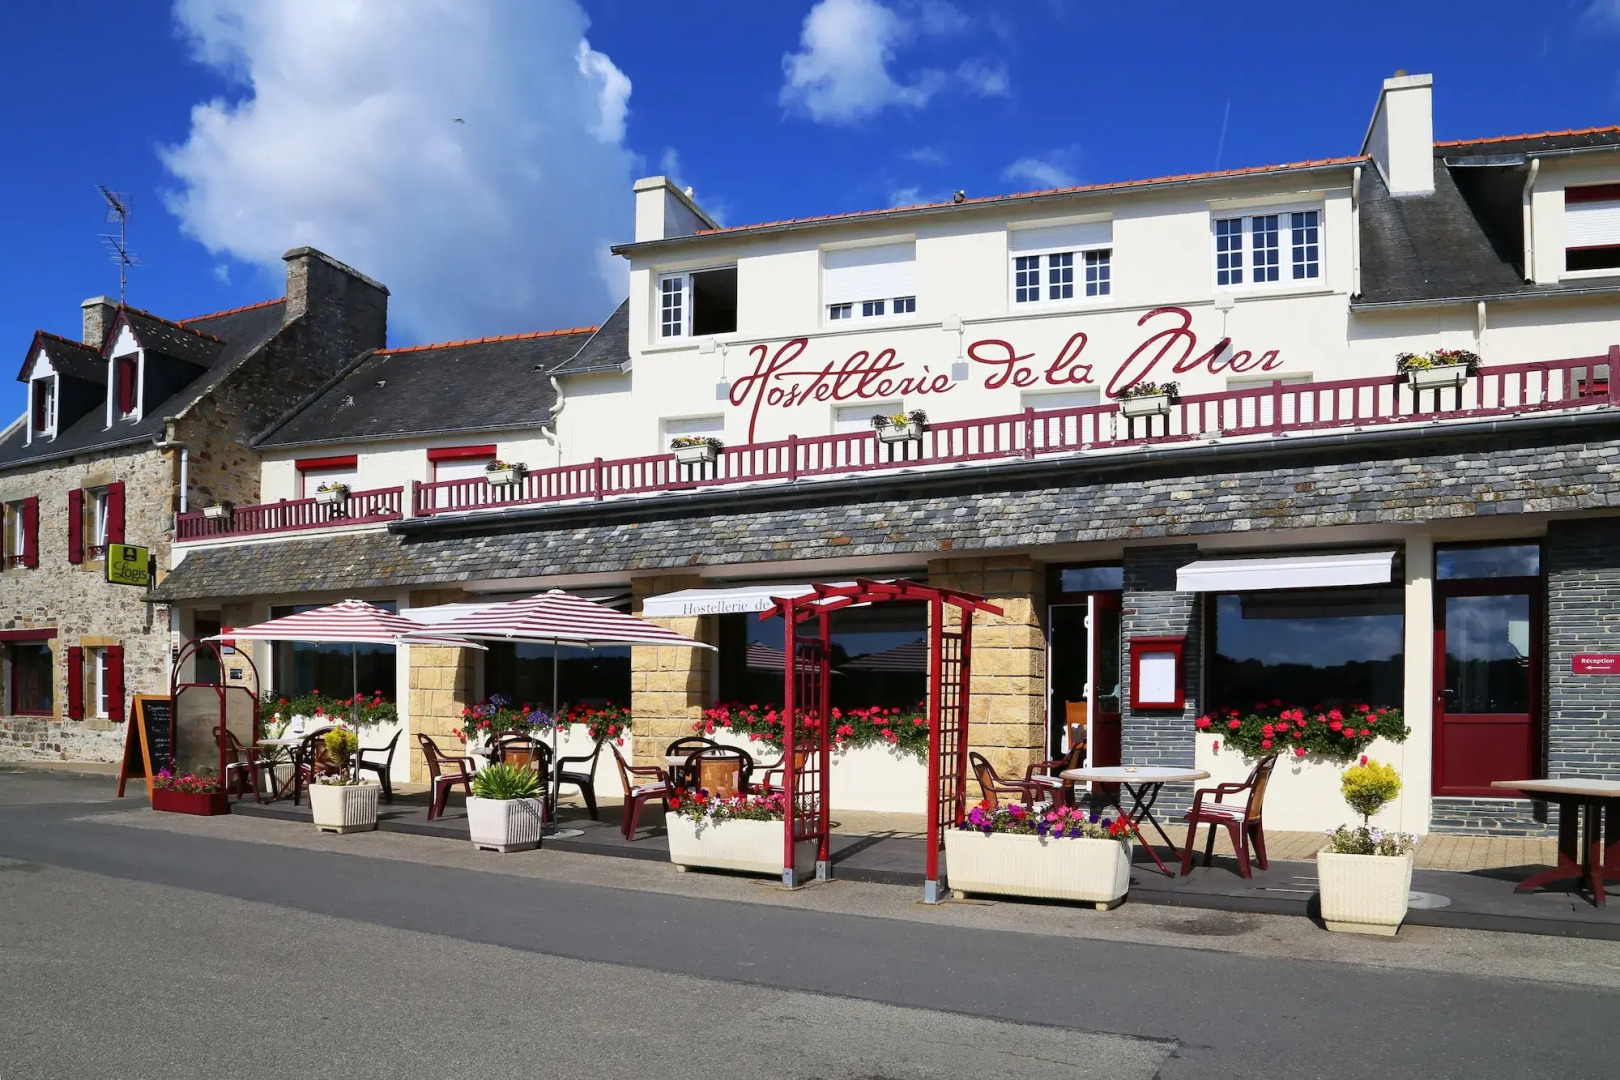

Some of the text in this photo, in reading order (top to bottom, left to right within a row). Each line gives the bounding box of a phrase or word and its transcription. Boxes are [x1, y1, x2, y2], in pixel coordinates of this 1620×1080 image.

[1043, 332, 1094, 385] la
[1105, 306, 1284, 398] Mer
[112, 561, 147, 582] Logis
[683, 598, 770, 614] Hostellerie de
